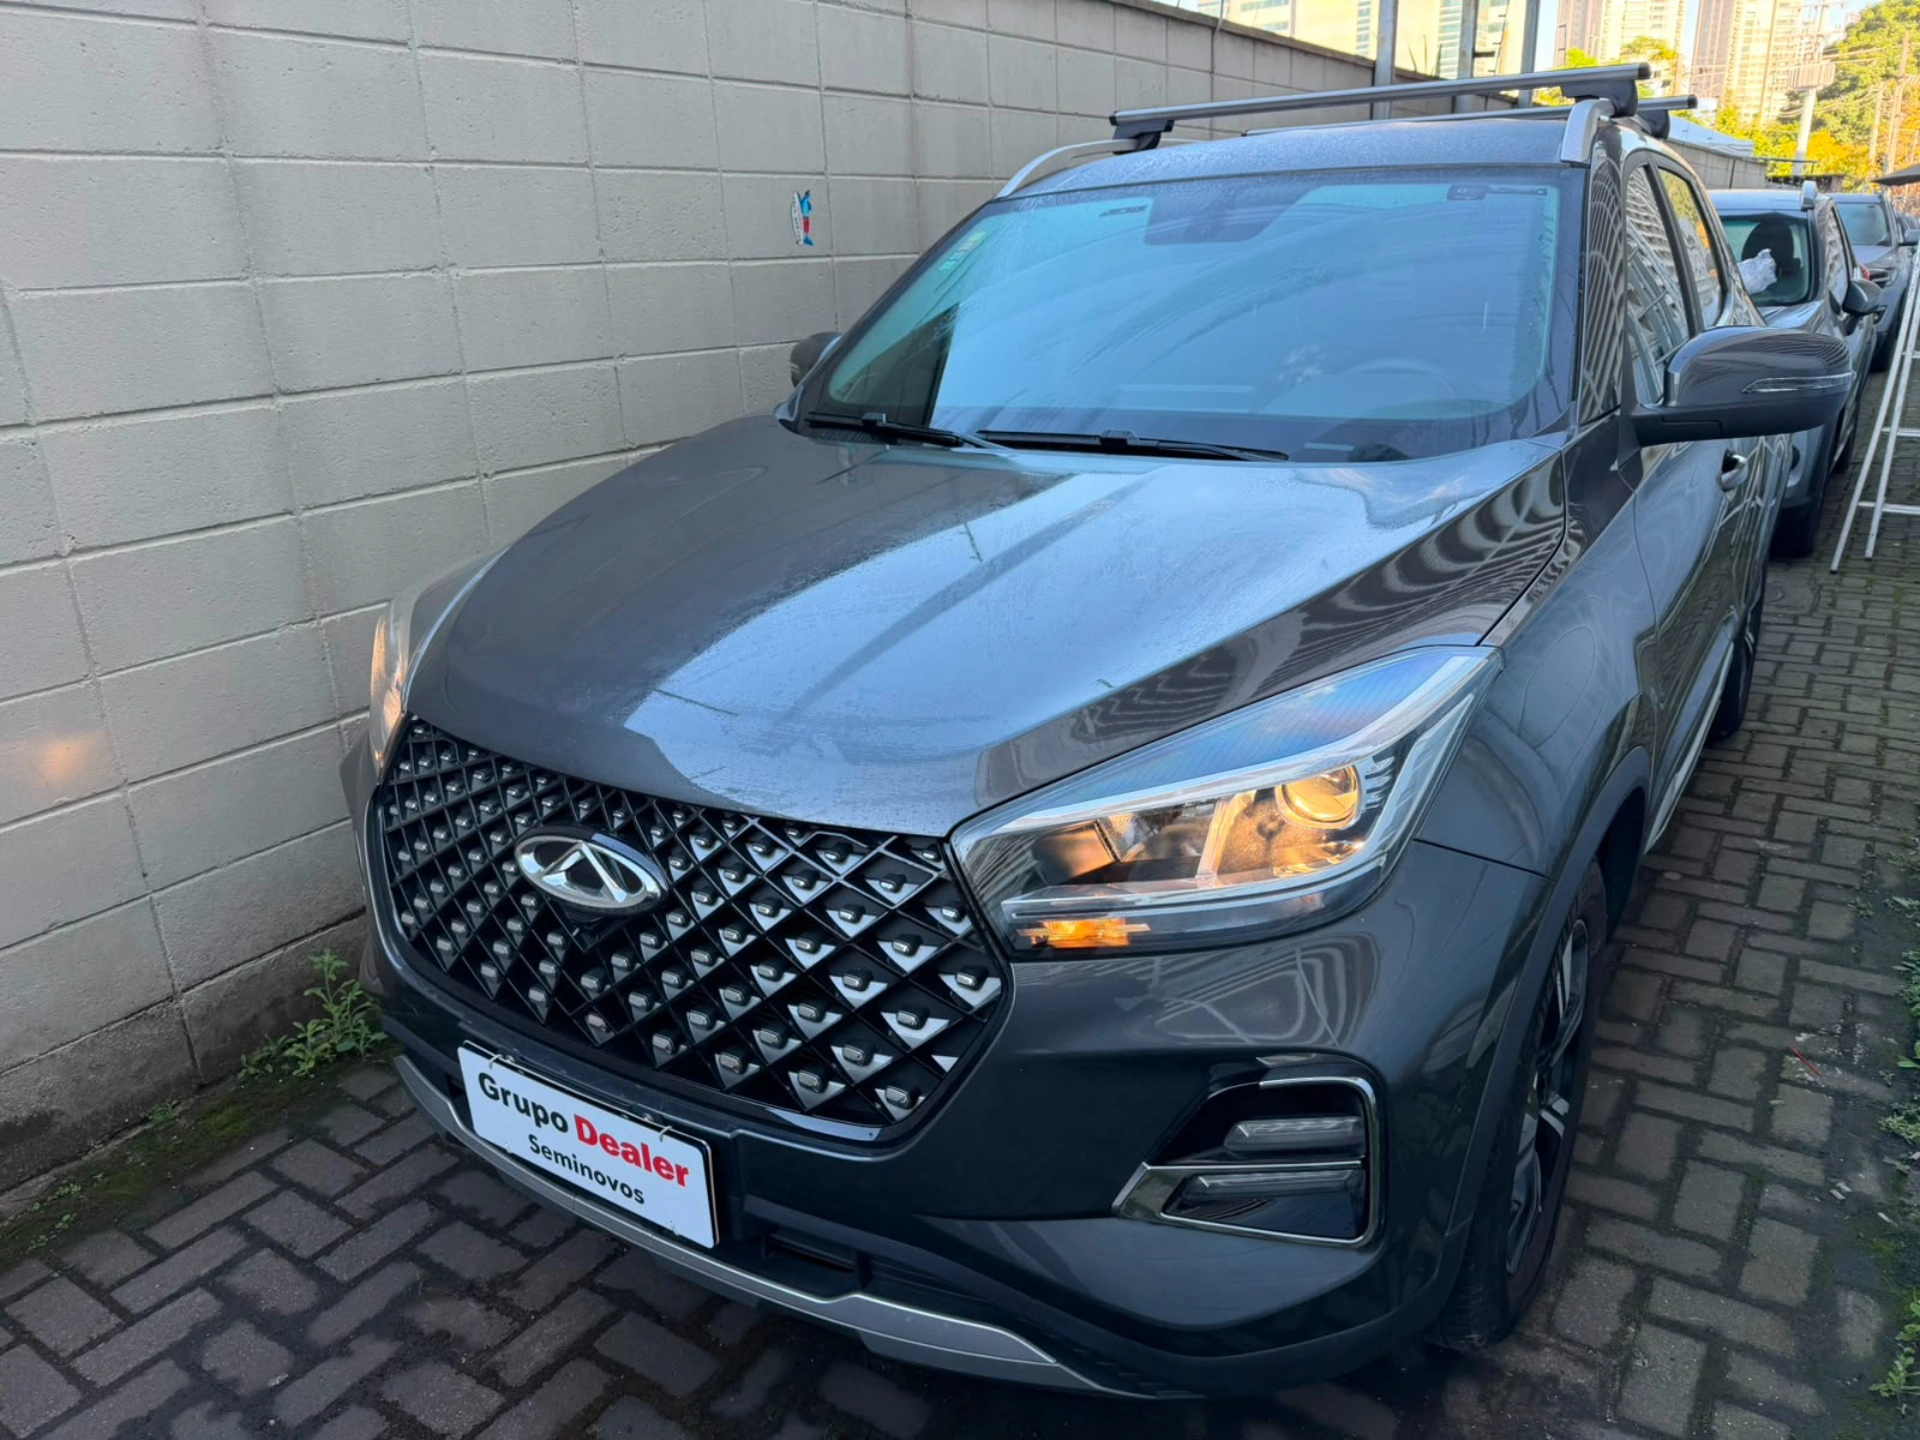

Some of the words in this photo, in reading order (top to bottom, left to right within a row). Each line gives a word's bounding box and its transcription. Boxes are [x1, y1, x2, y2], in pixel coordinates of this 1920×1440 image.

[478, 1072, 569, 1133] Grupo
[573, 1114, 689, 1187] Dealer
[528, 1134, 645, 1204] Seminovos
